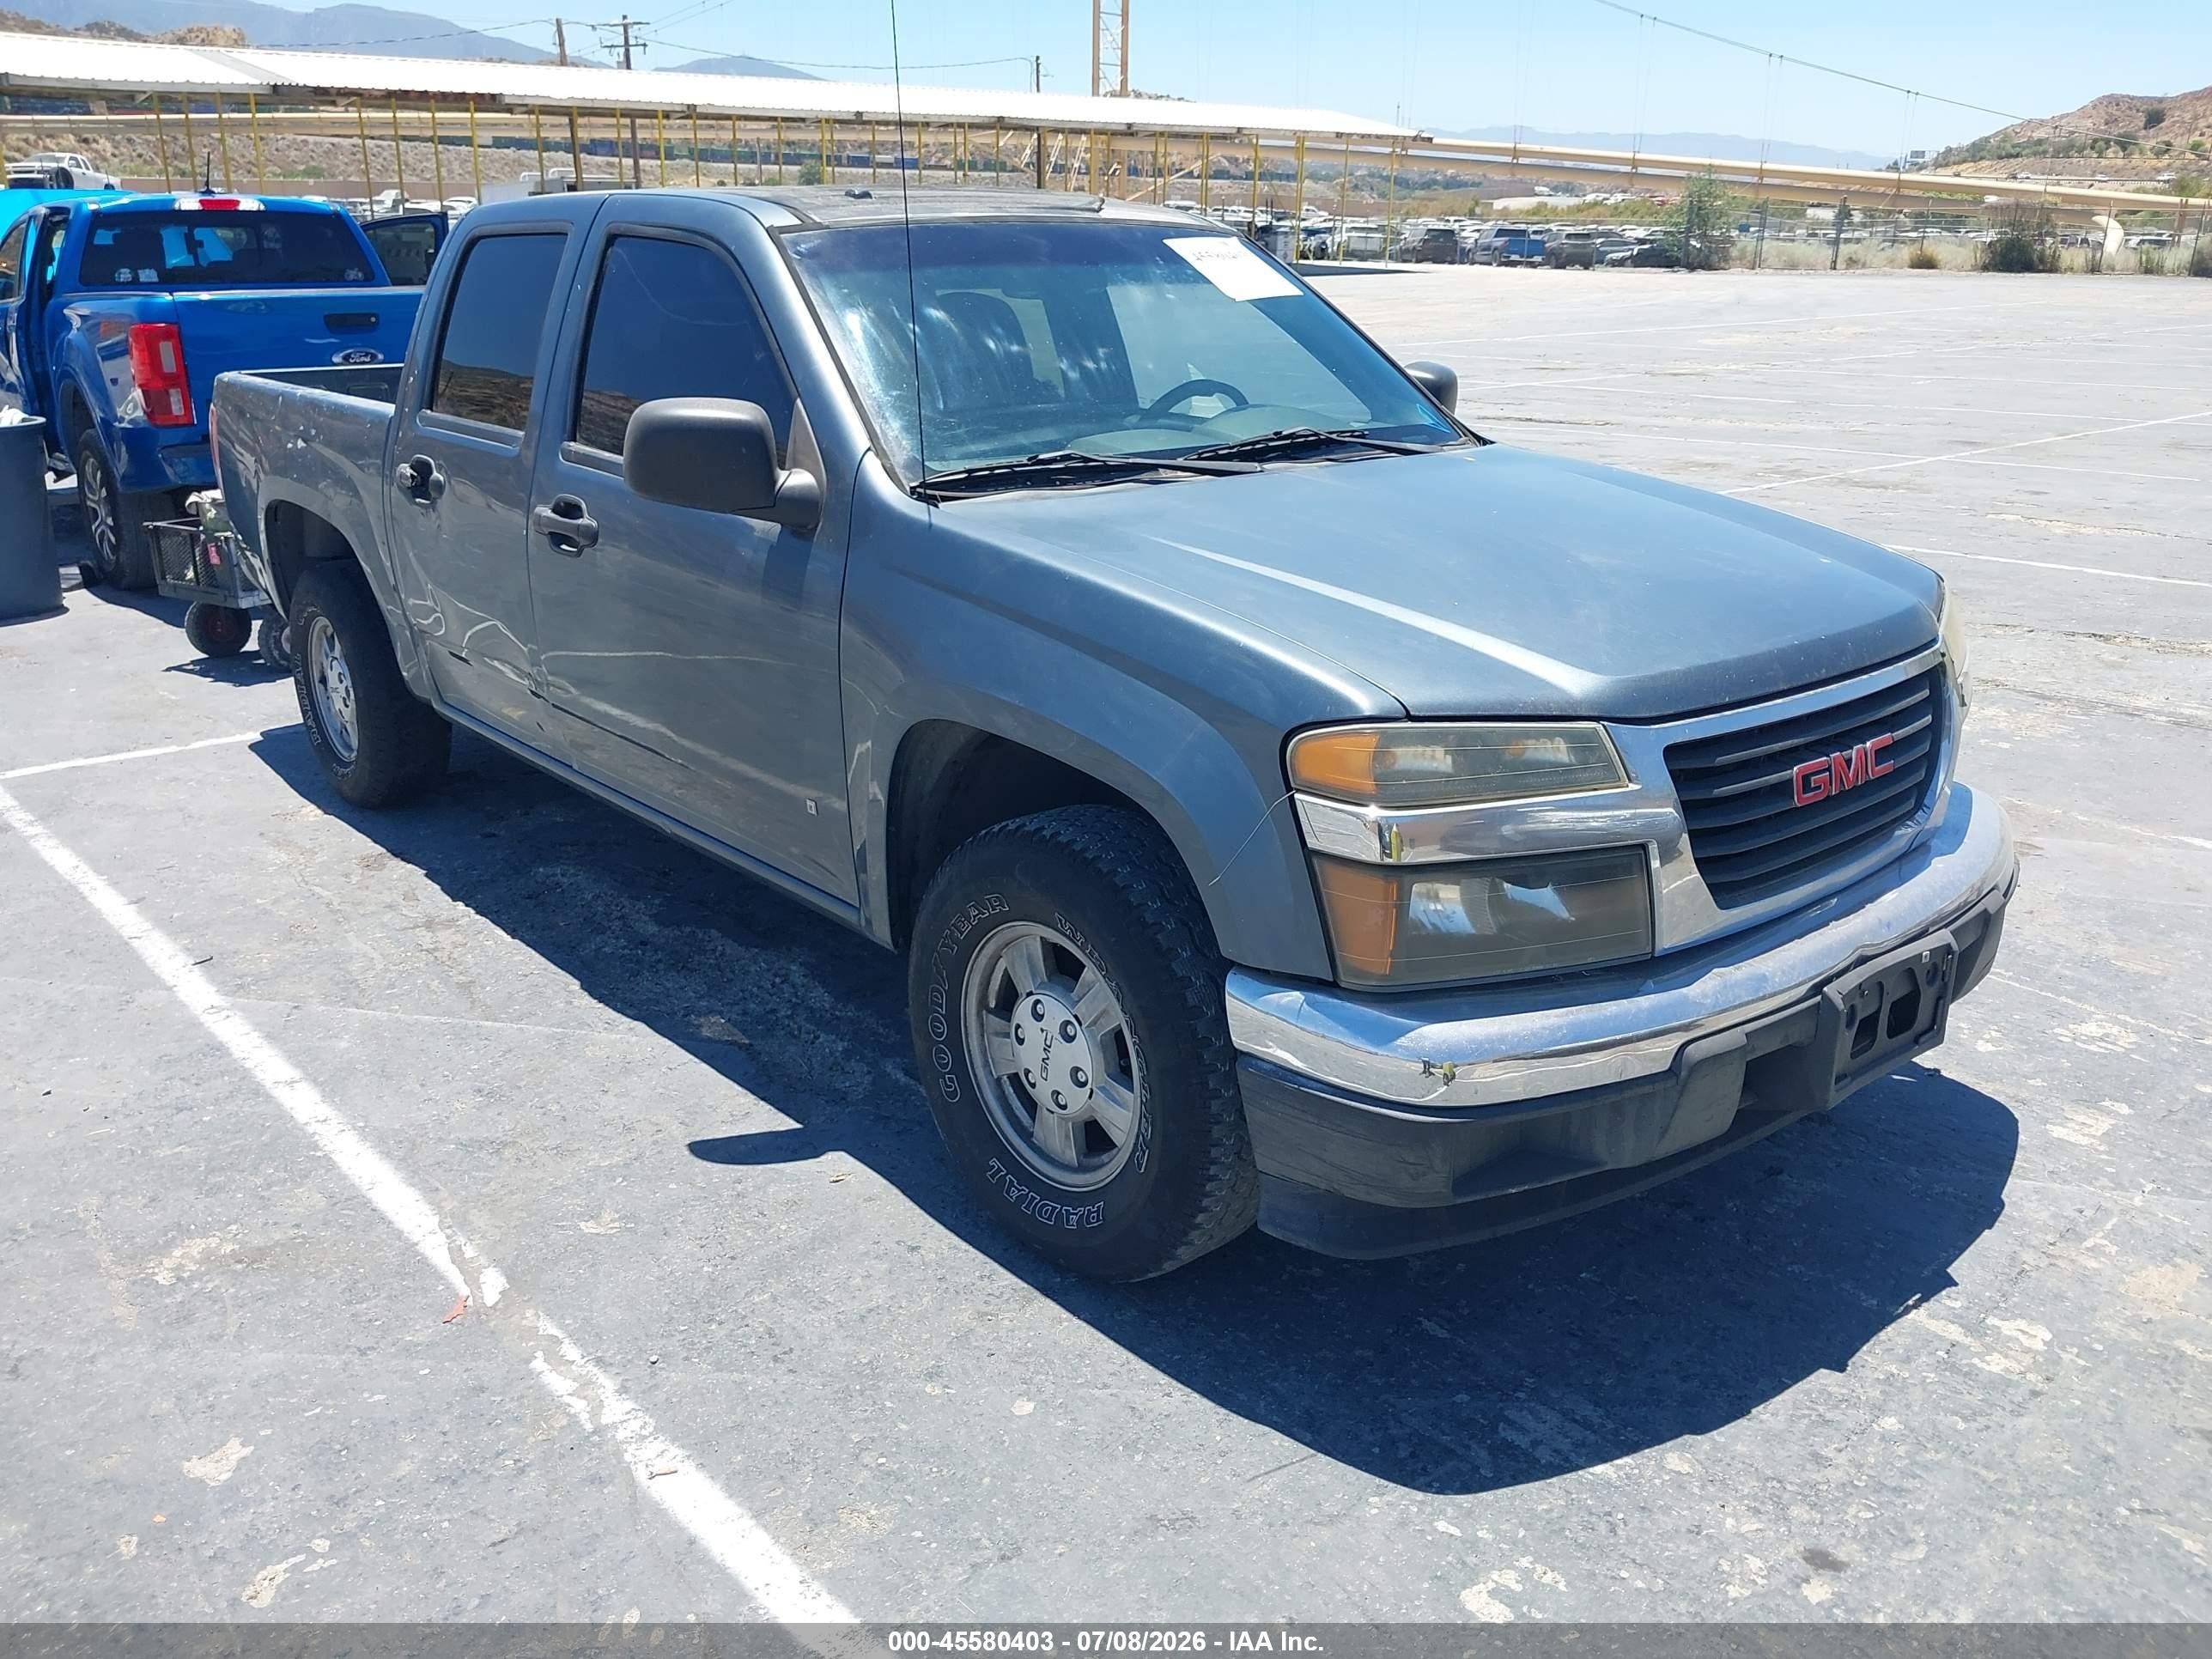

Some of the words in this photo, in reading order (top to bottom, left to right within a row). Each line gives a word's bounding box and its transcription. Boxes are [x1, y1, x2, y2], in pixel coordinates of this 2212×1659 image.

[349, 352, 371, 363] Ford
[1793, 732, 1894, 807] GMC
[928, 894, 1010, 1103] GOODYEAR
[1040, 1030, 1054, 1082] GMC
[1054, 912, 1153, 1173] WRANGLER
[988, 1158, 1105, 1230] RADIAL
